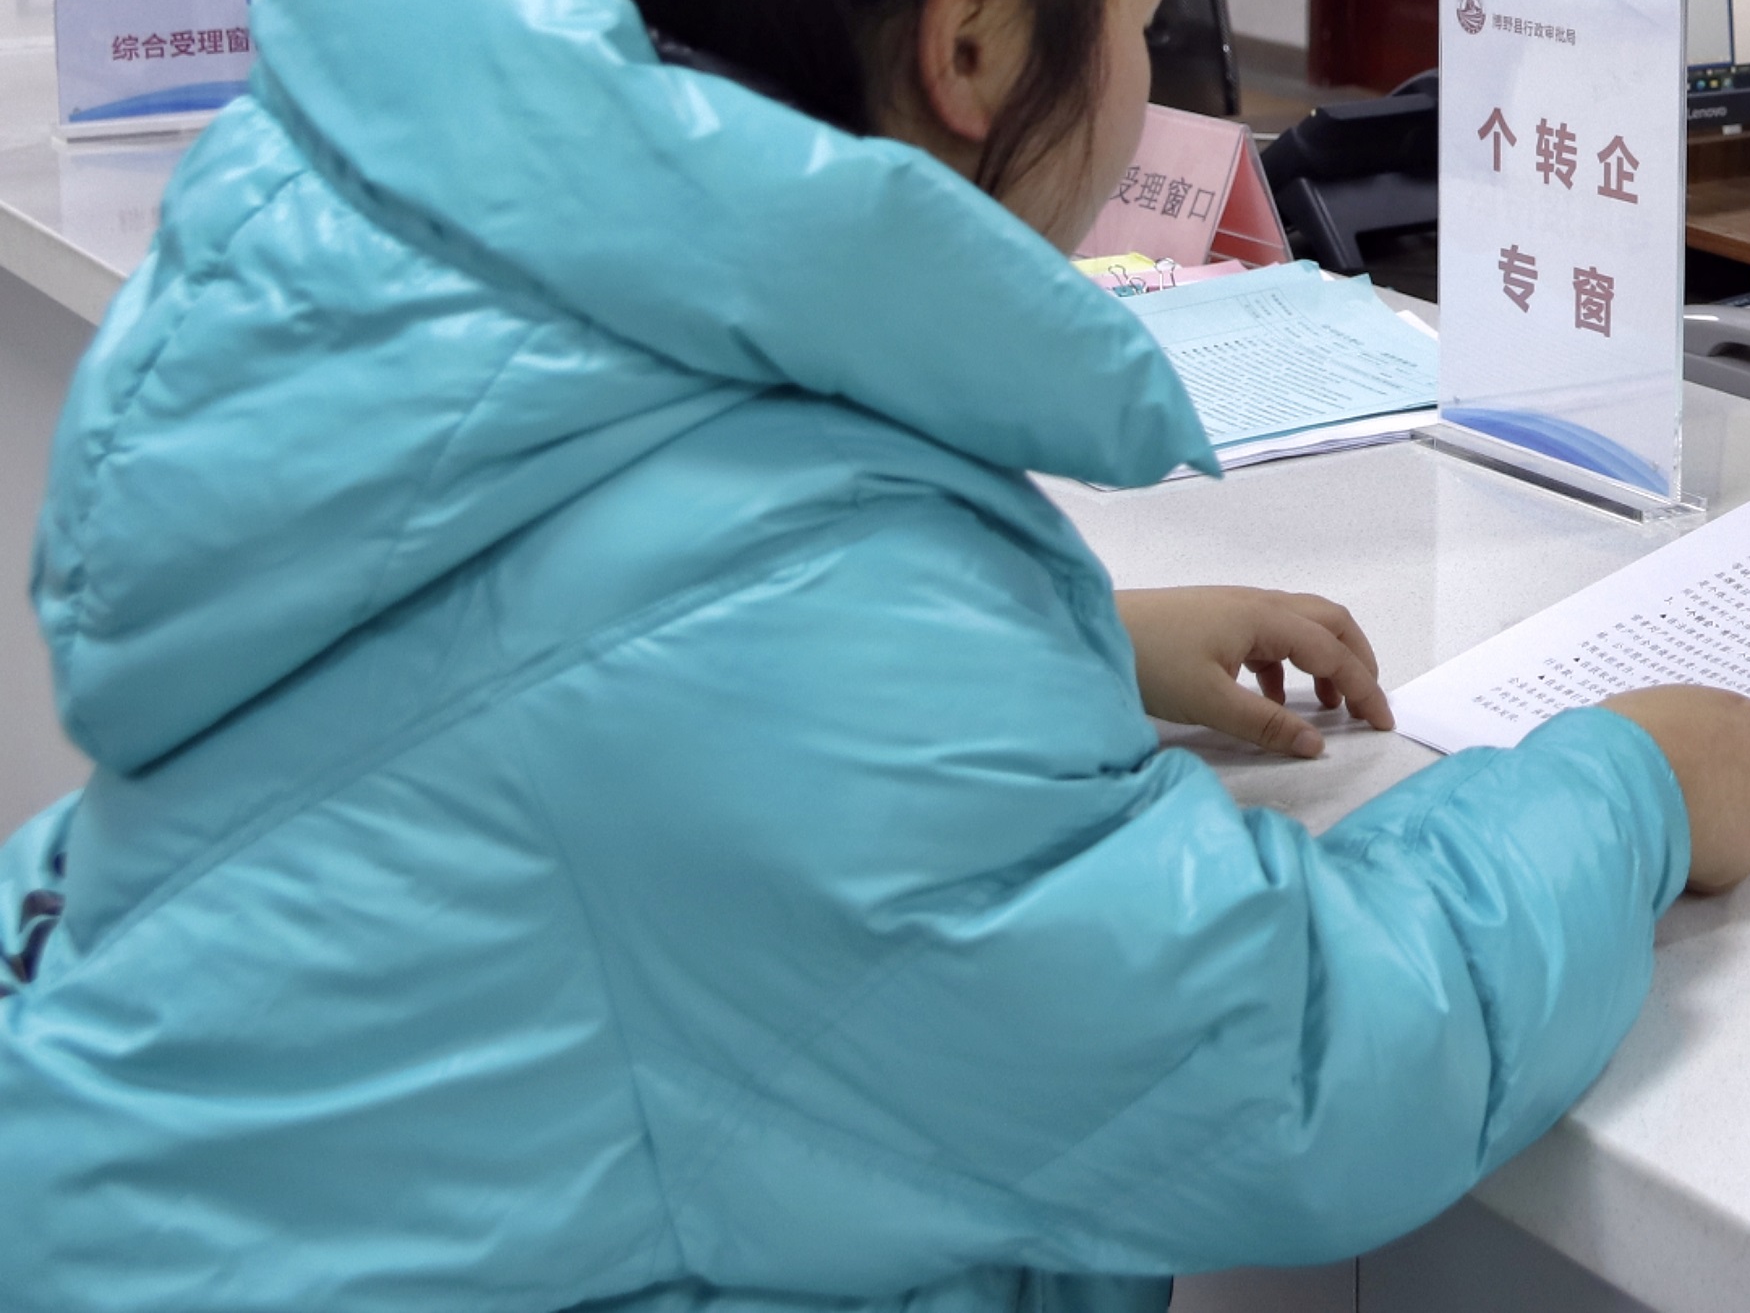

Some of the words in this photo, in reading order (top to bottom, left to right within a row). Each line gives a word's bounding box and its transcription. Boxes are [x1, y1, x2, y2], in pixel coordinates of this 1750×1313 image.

[1491, 12, 1576, 45] 博野县行政审批局
[1477, 106, 1640, 205] 个转企
